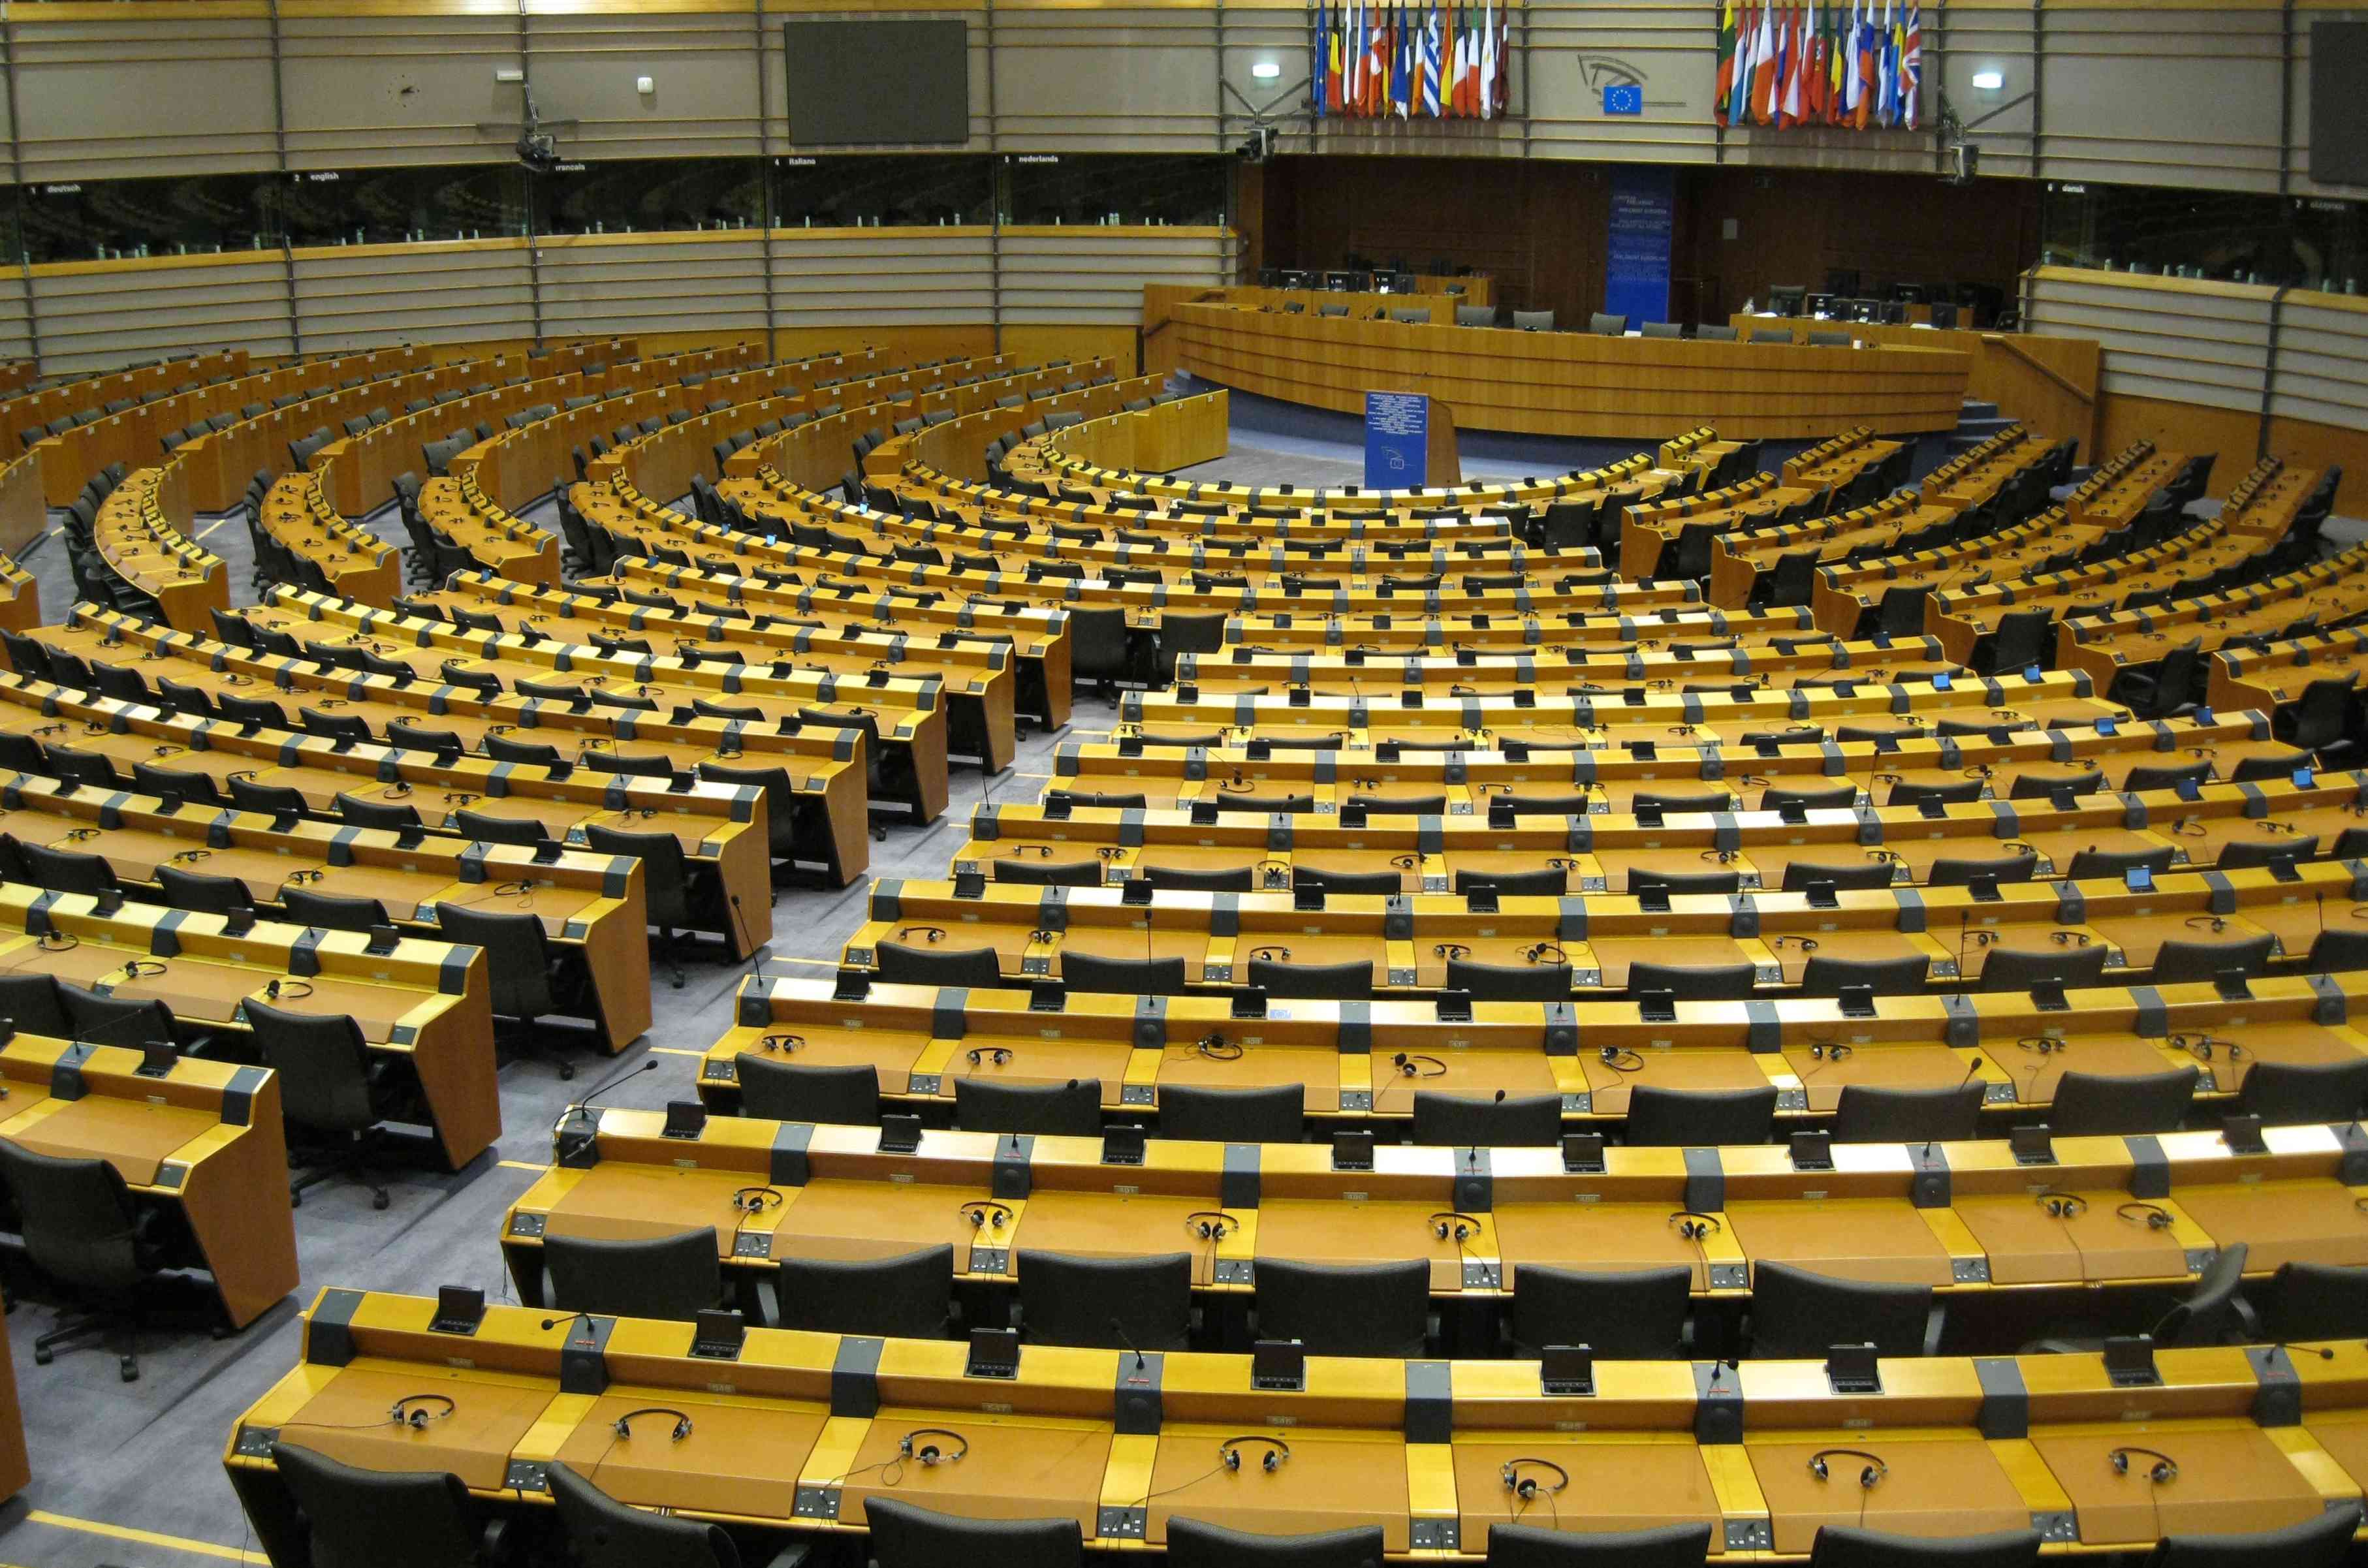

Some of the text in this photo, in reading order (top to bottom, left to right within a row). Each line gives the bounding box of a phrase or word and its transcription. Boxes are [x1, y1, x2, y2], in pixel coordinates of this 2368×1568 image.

[310, 172, 339, 181] english
[47, 183, 82, 193] deutsch
[2062, 184, 2085, 193] dansk
